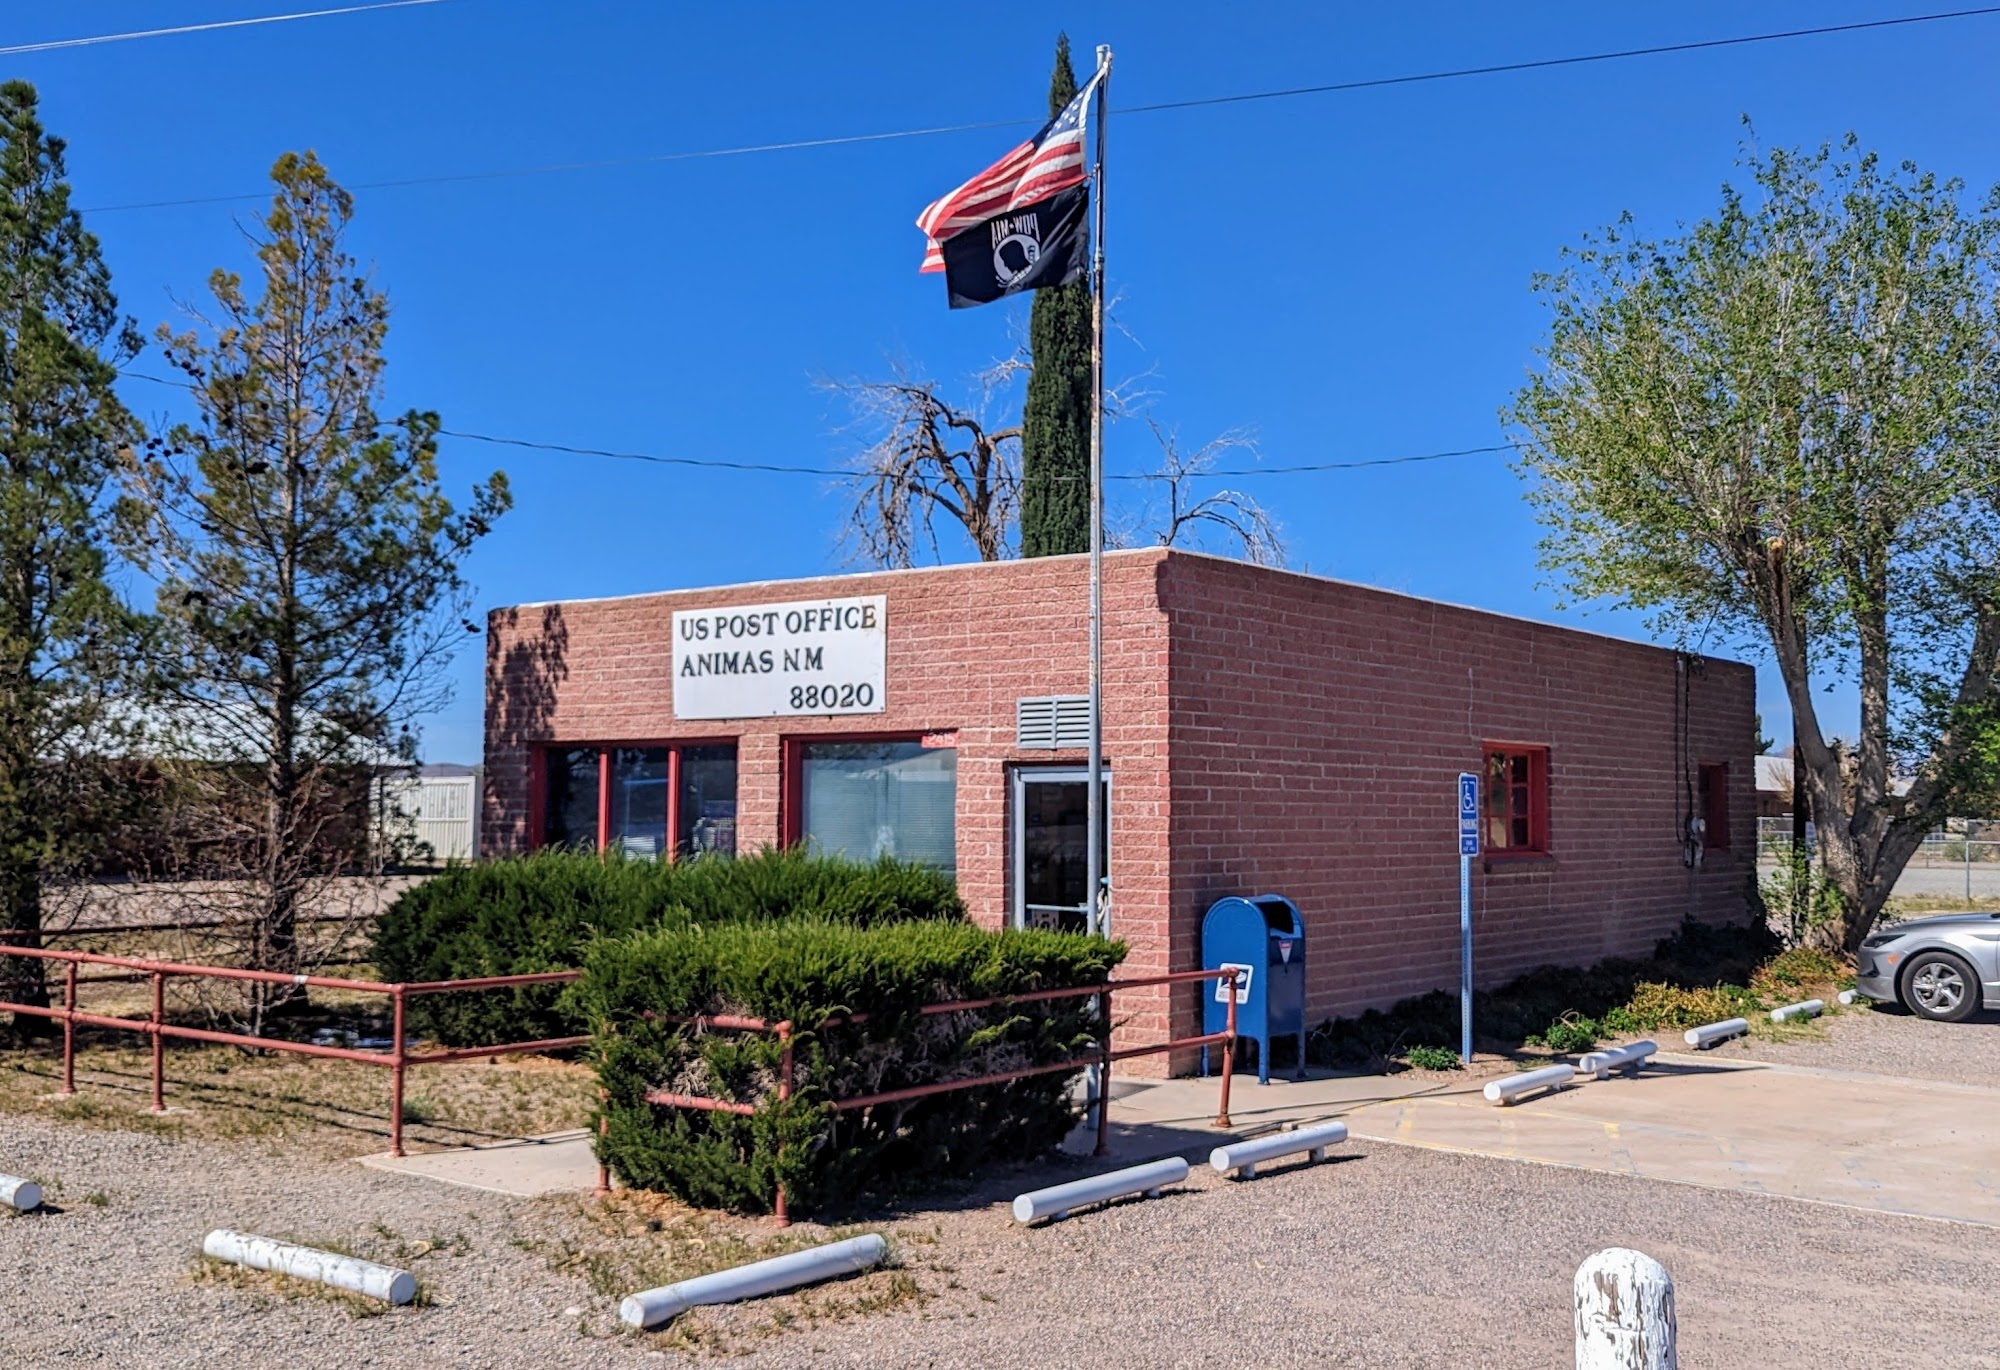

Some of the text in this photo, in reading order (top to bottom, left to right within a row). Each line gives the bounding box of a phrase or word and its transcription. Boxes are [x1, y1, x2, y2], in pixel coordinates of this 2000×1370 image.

[680, 605, 877, 641] US POST OFFICE
[680, 650, 774, 677] ANIMAS
[790, 683, 874, 709] 88020
